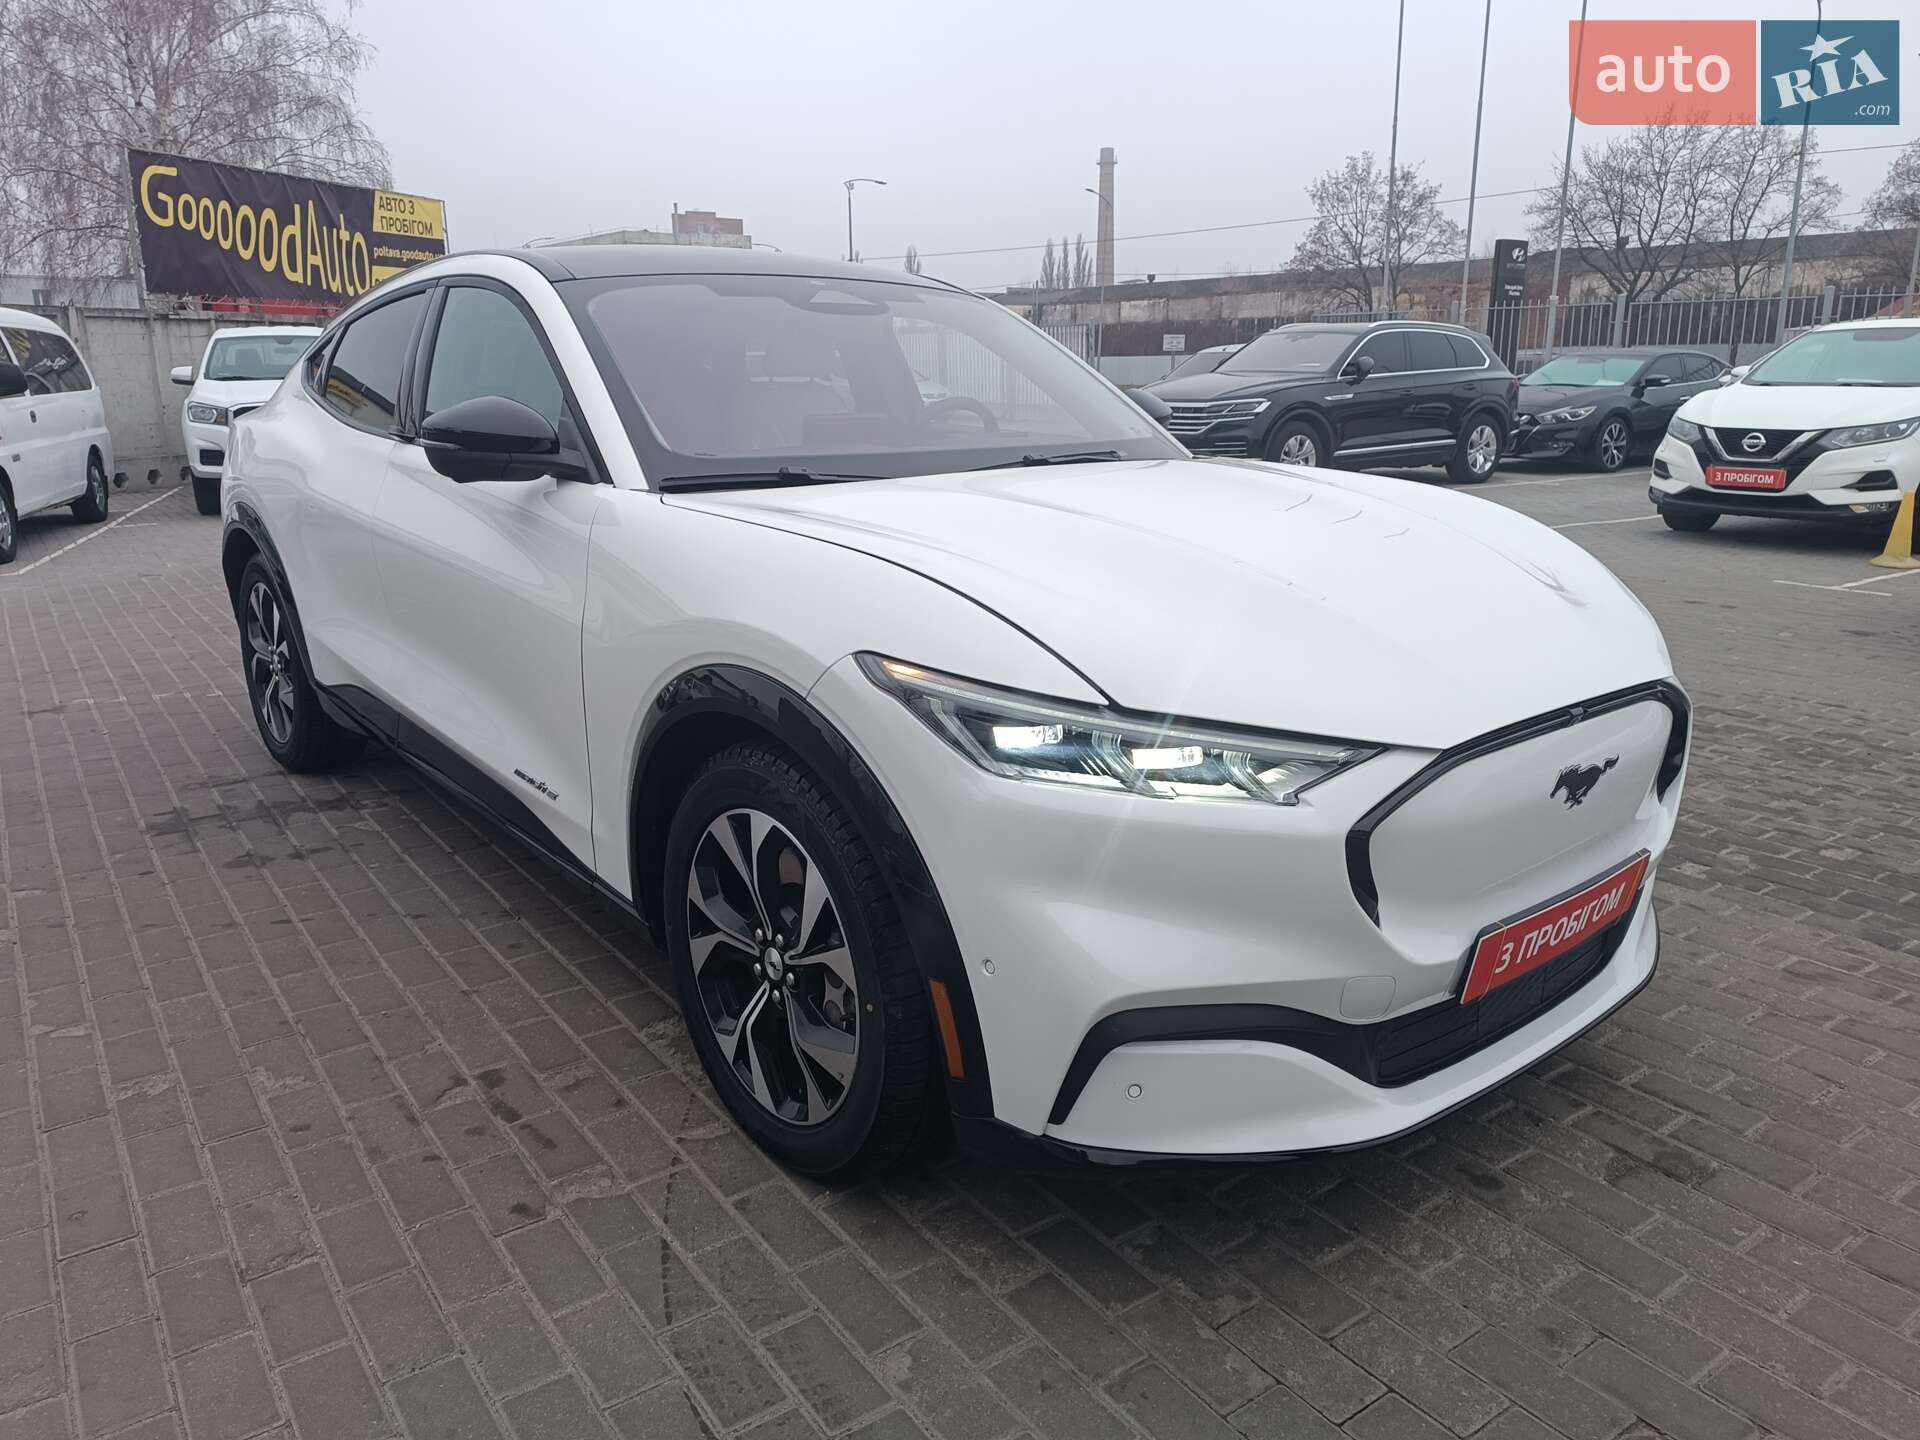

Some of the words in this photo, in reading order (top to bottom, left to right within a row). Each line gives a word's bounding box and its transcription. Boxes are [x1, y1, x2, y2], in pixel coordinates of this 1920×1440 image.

[379, 196, 406, 213] АВТО
[380, 216, 433, 236] ПРОБІГОМ
[1724, 473, 1774, 484] ПРОБІГОМ
[1494, 942, 1514, 974] З
[1516, 881, 1625, 964] ПРОБІГОМ
